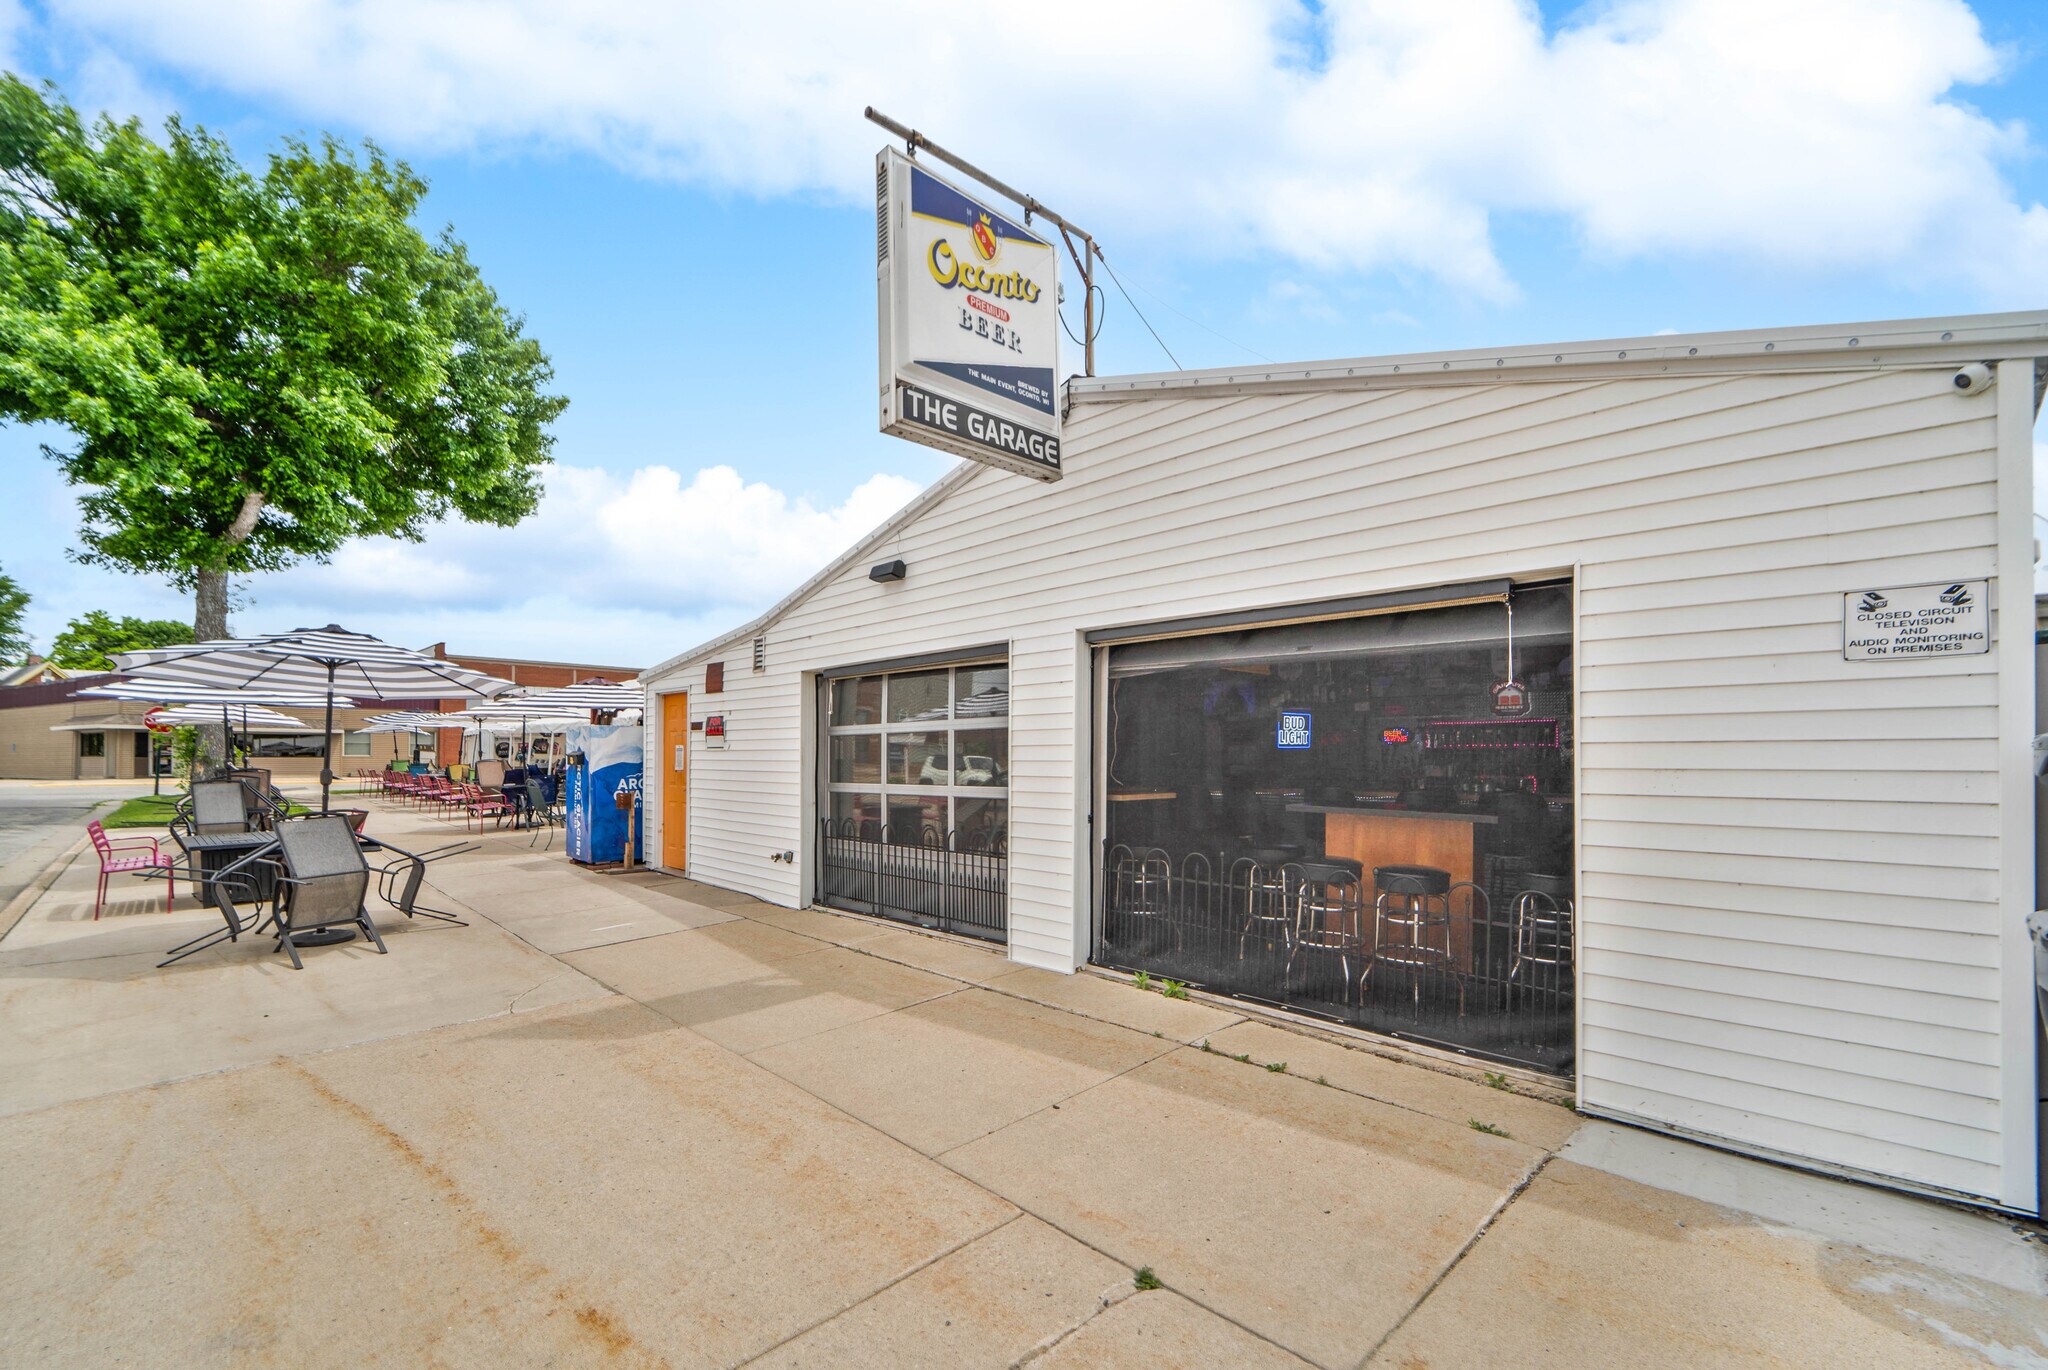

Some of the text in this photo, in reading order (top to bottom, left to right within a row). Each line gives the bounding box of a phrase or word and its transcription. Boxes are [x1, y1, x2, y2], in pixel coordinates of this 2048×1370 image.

[927, 239, 1041, 303] Oconto
[970, 297, 1008, 321] PREMIUM
[958, 306, 1023, 354] BEER
[968, 368, 1050, 406] THE MAIN EVENT, OCONTO, WI
[1017, 380, 1049, 398] BREWED BY
[907, 389, 1058, 465] THE GARAGE
[1857, 606, 1974, 621] CLOSED CIRCUIT
[1875, 616, 1955, 629] TELEVISION
[1900, 627, 1928, 635] AND
[1849, 632, 1984, 648] AUDIO MONITORING
[1867, 642, 1963, 655] ON PREMISES
[710, 717, 721, 726] FOR
[1283, 715, 1305, 731] BUD
[706, 726, 723, 735] SALE
[1278, 730, 1309, 745] LIGHT
